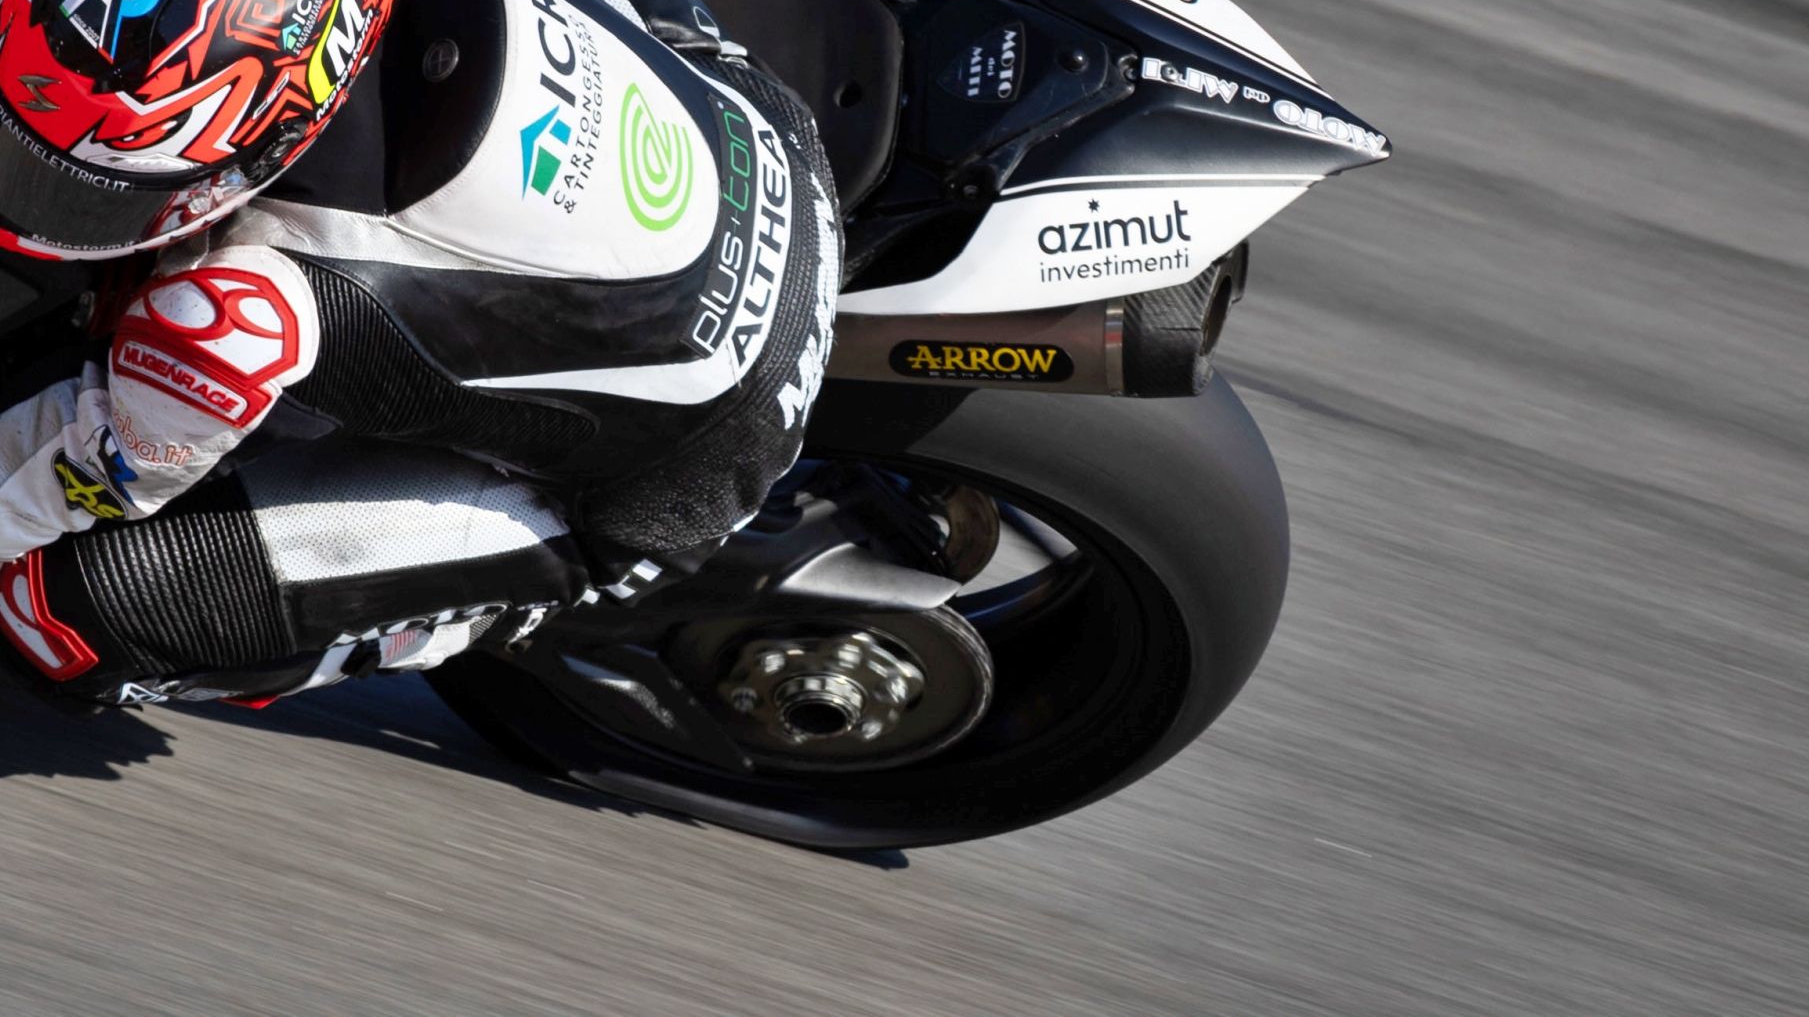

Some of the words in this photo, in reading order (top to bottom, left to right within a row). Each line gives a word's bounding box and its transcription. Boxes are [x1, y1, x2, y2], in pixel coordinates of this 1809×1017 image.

[1272, 99, 1388, 157] MOTO
[728, 124, 788, 370] ALTHEA
[1038, 199, 1192, 256] azimut
[1039, 248, 1190, 283] investimenti
[121, 342, 240, 414] MUGENRACE
[907, 344, 1058, 374] ARROW
